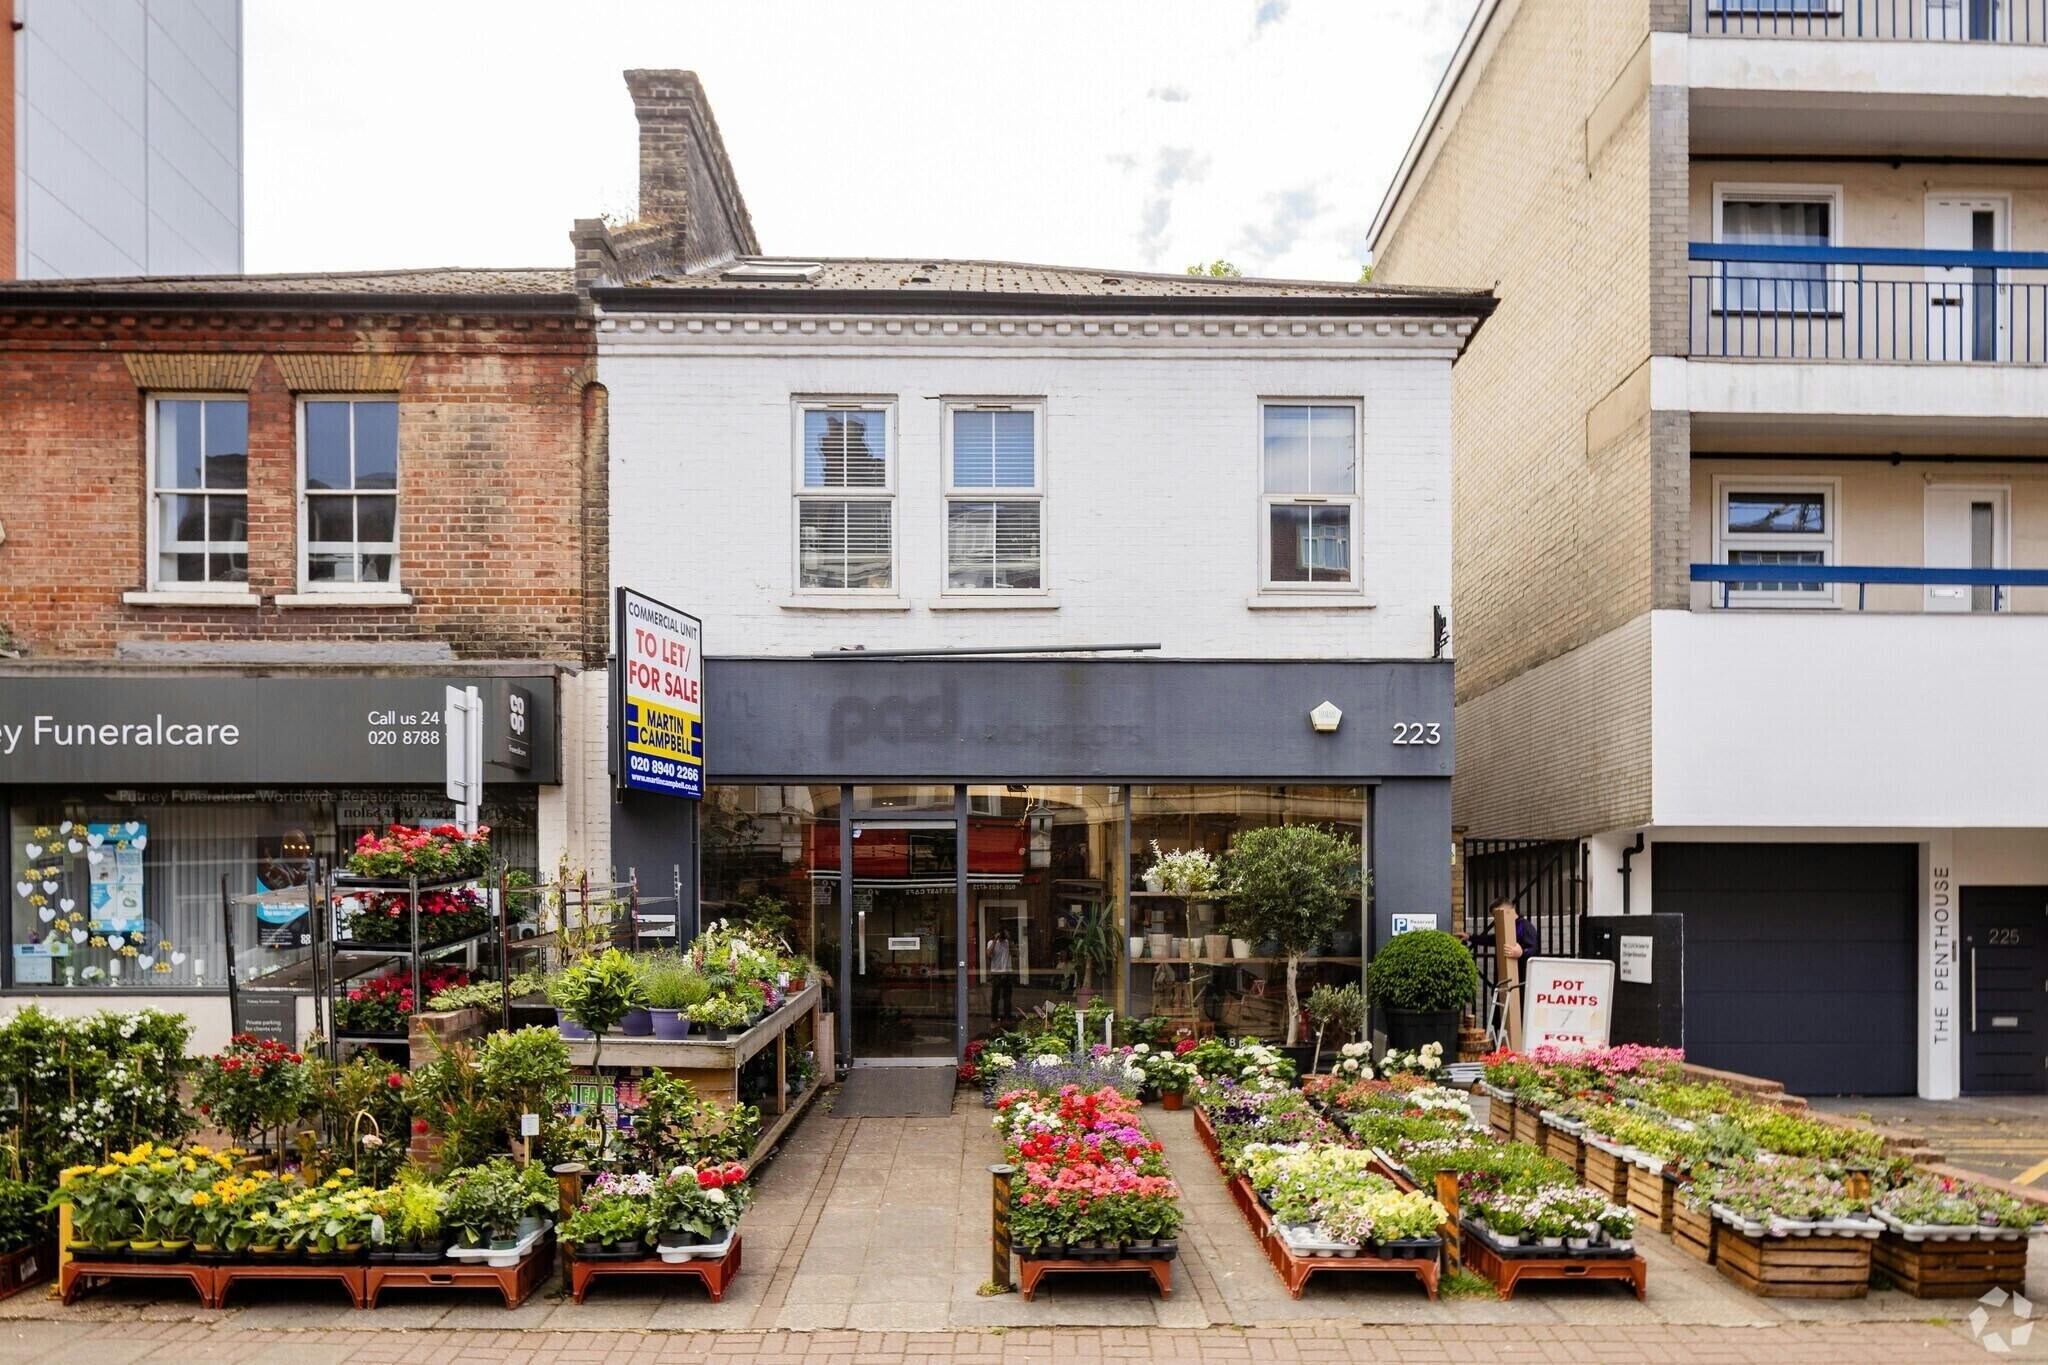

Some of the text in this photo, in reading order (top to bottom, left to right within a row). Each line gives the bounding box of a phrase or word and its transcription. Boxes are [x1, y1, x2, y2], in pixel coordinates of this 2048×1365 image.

[628, 601, 697, 640] COMMERCIAL UNIT
[635, 628, 657, 658] TO
[629, 659, 698, 705] FOR SALE
[34, 713, 240, 746] Funeralcare
[367, 711, 440, 726] Call us 24
[647, 708, 684, 735] MARTIN
[367, 731, 440, 745] 020 8788
[640, 726, 691, 755] CAMPBELL
[1392, 722, 1441, 745] 223
[630, 755, 699, 782] 020 8940 2266
[1989, 928, 2020, 945] 225
[1934, 867, 1949, 1044] THE PENTHOUSE
[1552, 980, 1584, 991] POT
[1536, 993, 1598, 1006] PLANTS
[1544, 1034, 1585, 1044] FOR
[580, 1085, 615, 1104] FAR
